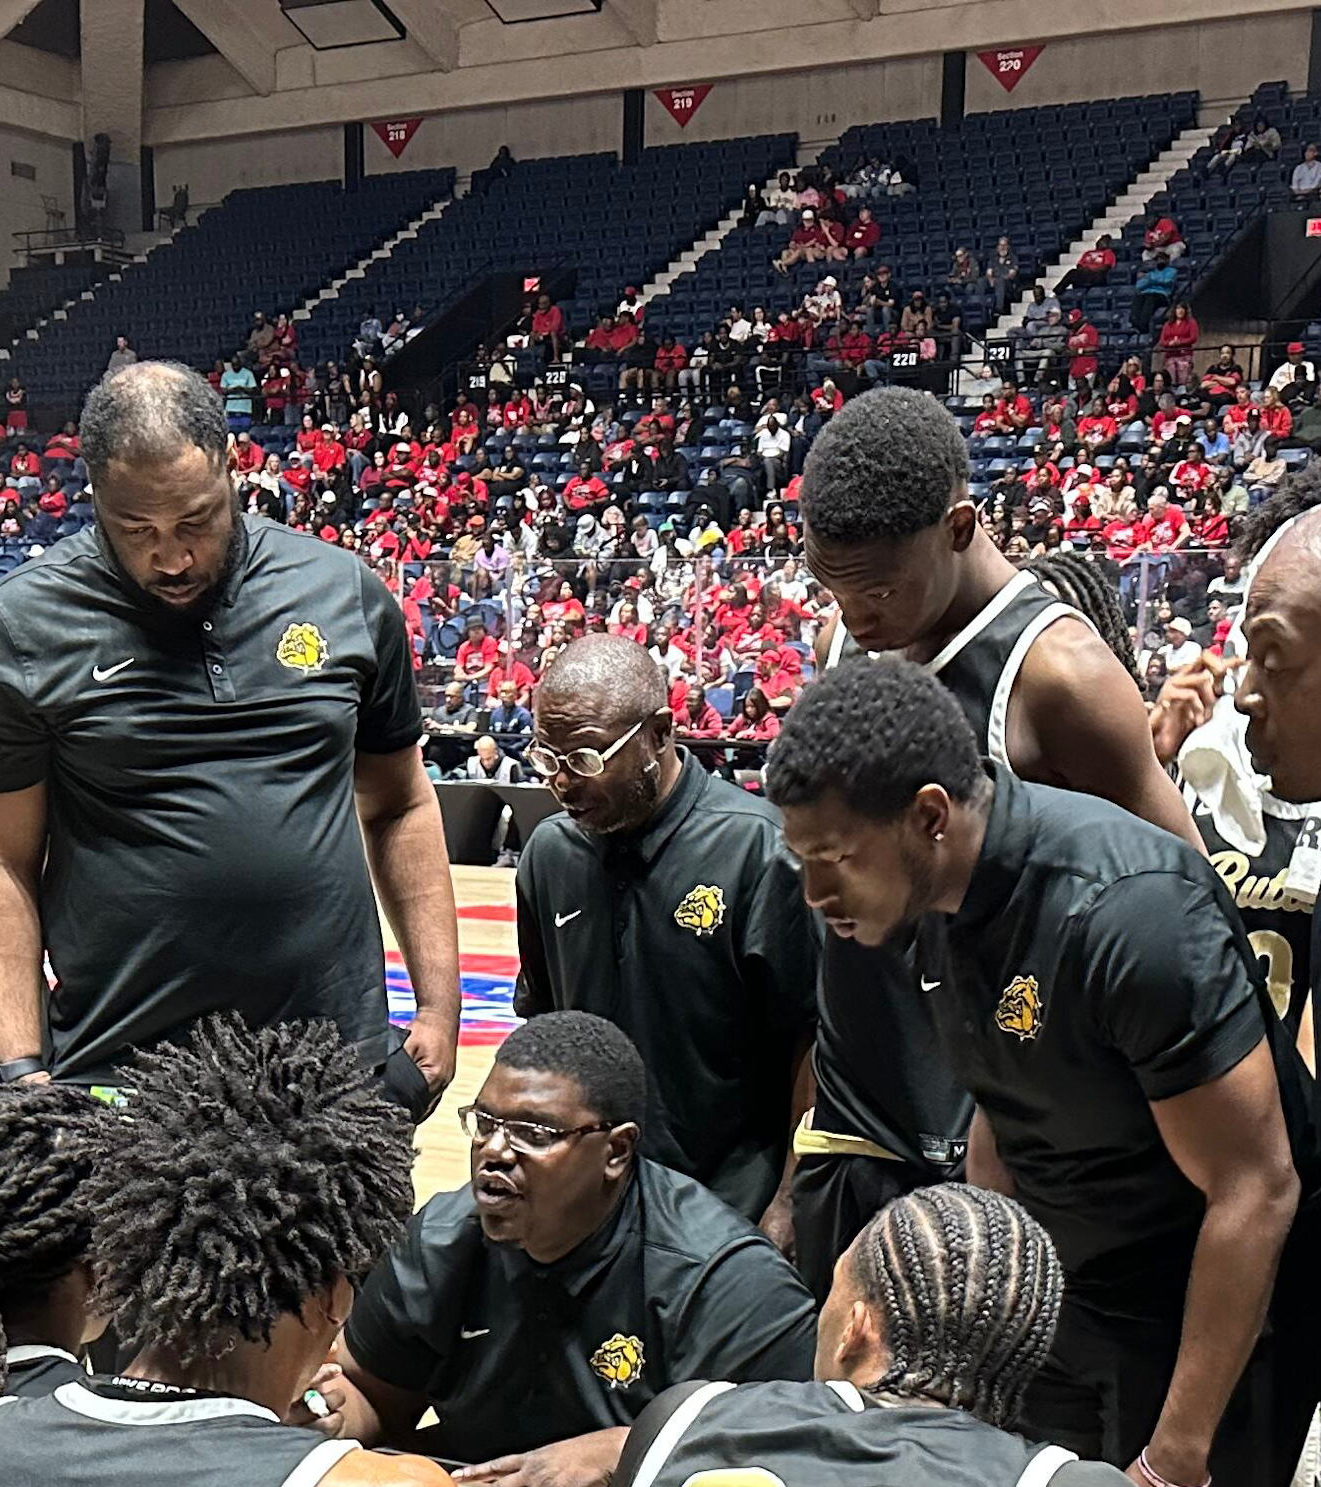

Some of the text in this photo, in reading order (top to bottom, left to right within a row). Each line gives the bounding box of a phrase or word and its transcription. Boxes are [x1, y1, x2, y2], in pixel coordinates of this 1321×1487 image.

[999, 59, 1022, 72] 220
[892, 352, 918, 367] 220
[953, 1145, 965, 1158] M
